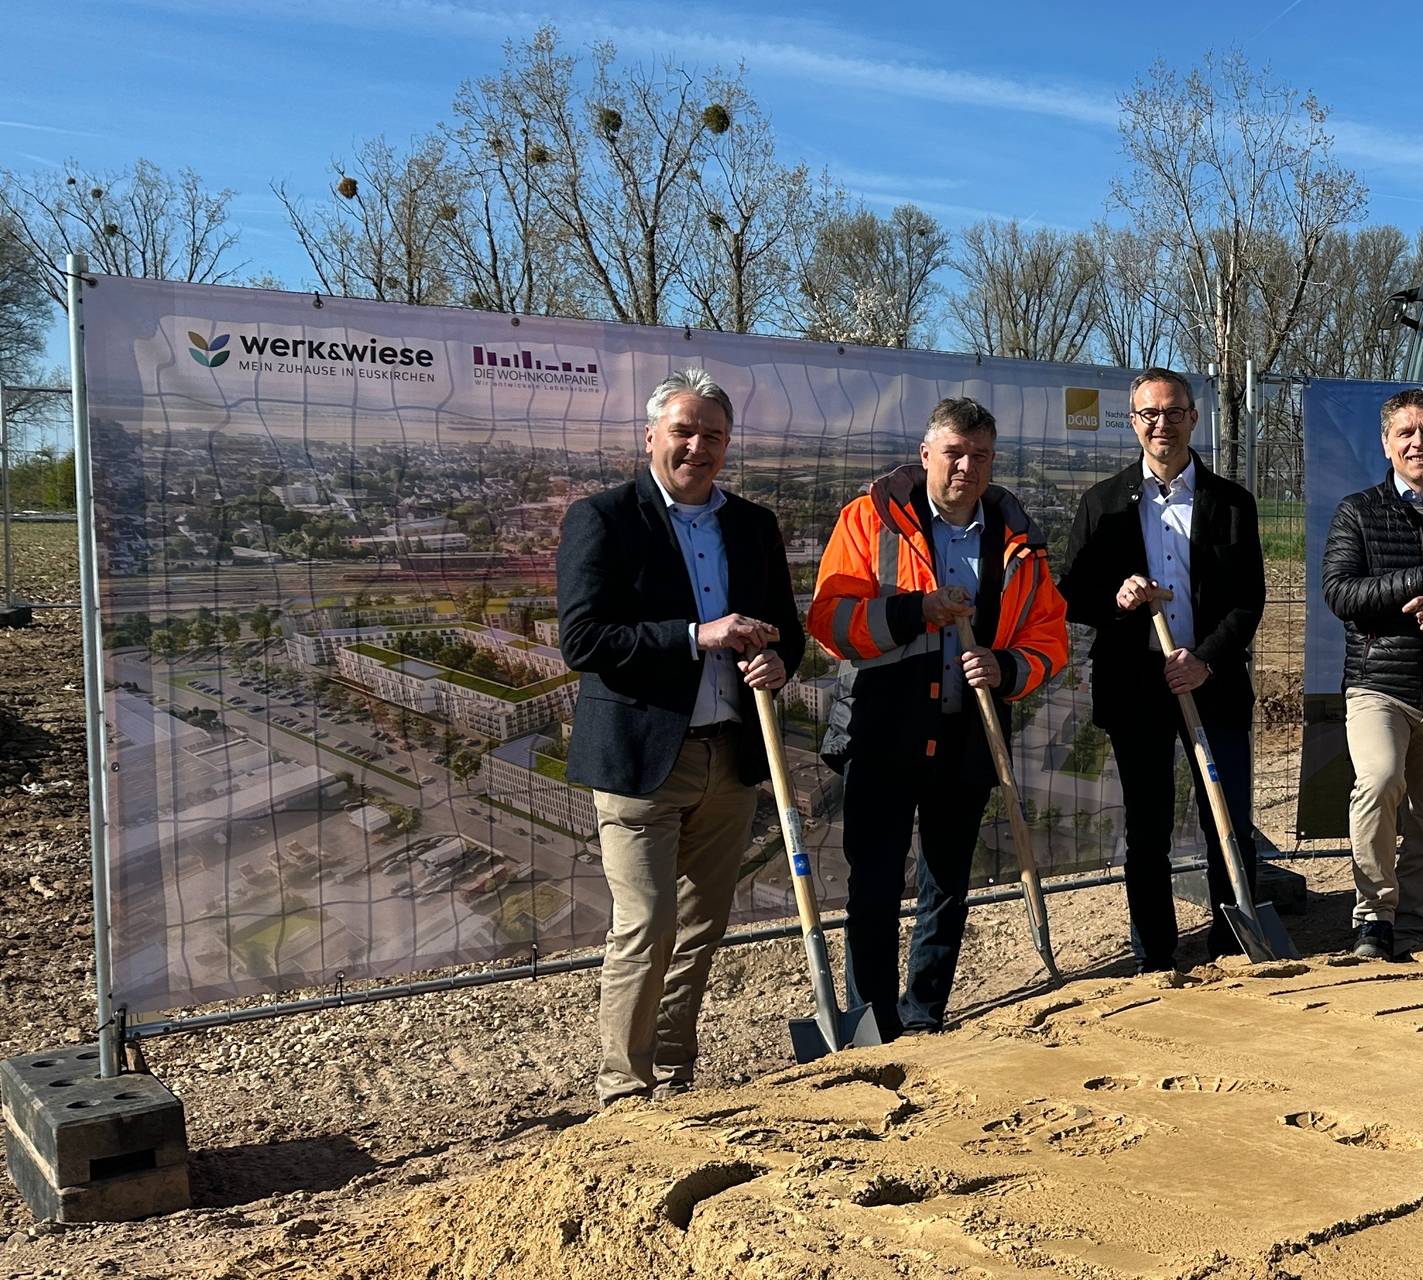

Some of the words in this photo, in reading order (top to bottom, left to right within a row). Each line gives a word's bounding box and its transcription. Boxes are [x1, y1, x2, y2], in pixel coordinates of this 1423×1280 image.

[240, 335, 434, 367] werk&wiese
[239, 360, 272, 372] MEIN
[278, 363, 337, 376] ZUHAUSE
[341, 368, 354, 377] IN
[359, 369, 435, 382] EUSKIRCHEN
[474, 367, 494, 379] DIE
[497, 370, 598, 386] WOHNKOMPANIE
[1067, 414, 1098, 427] DGNB
